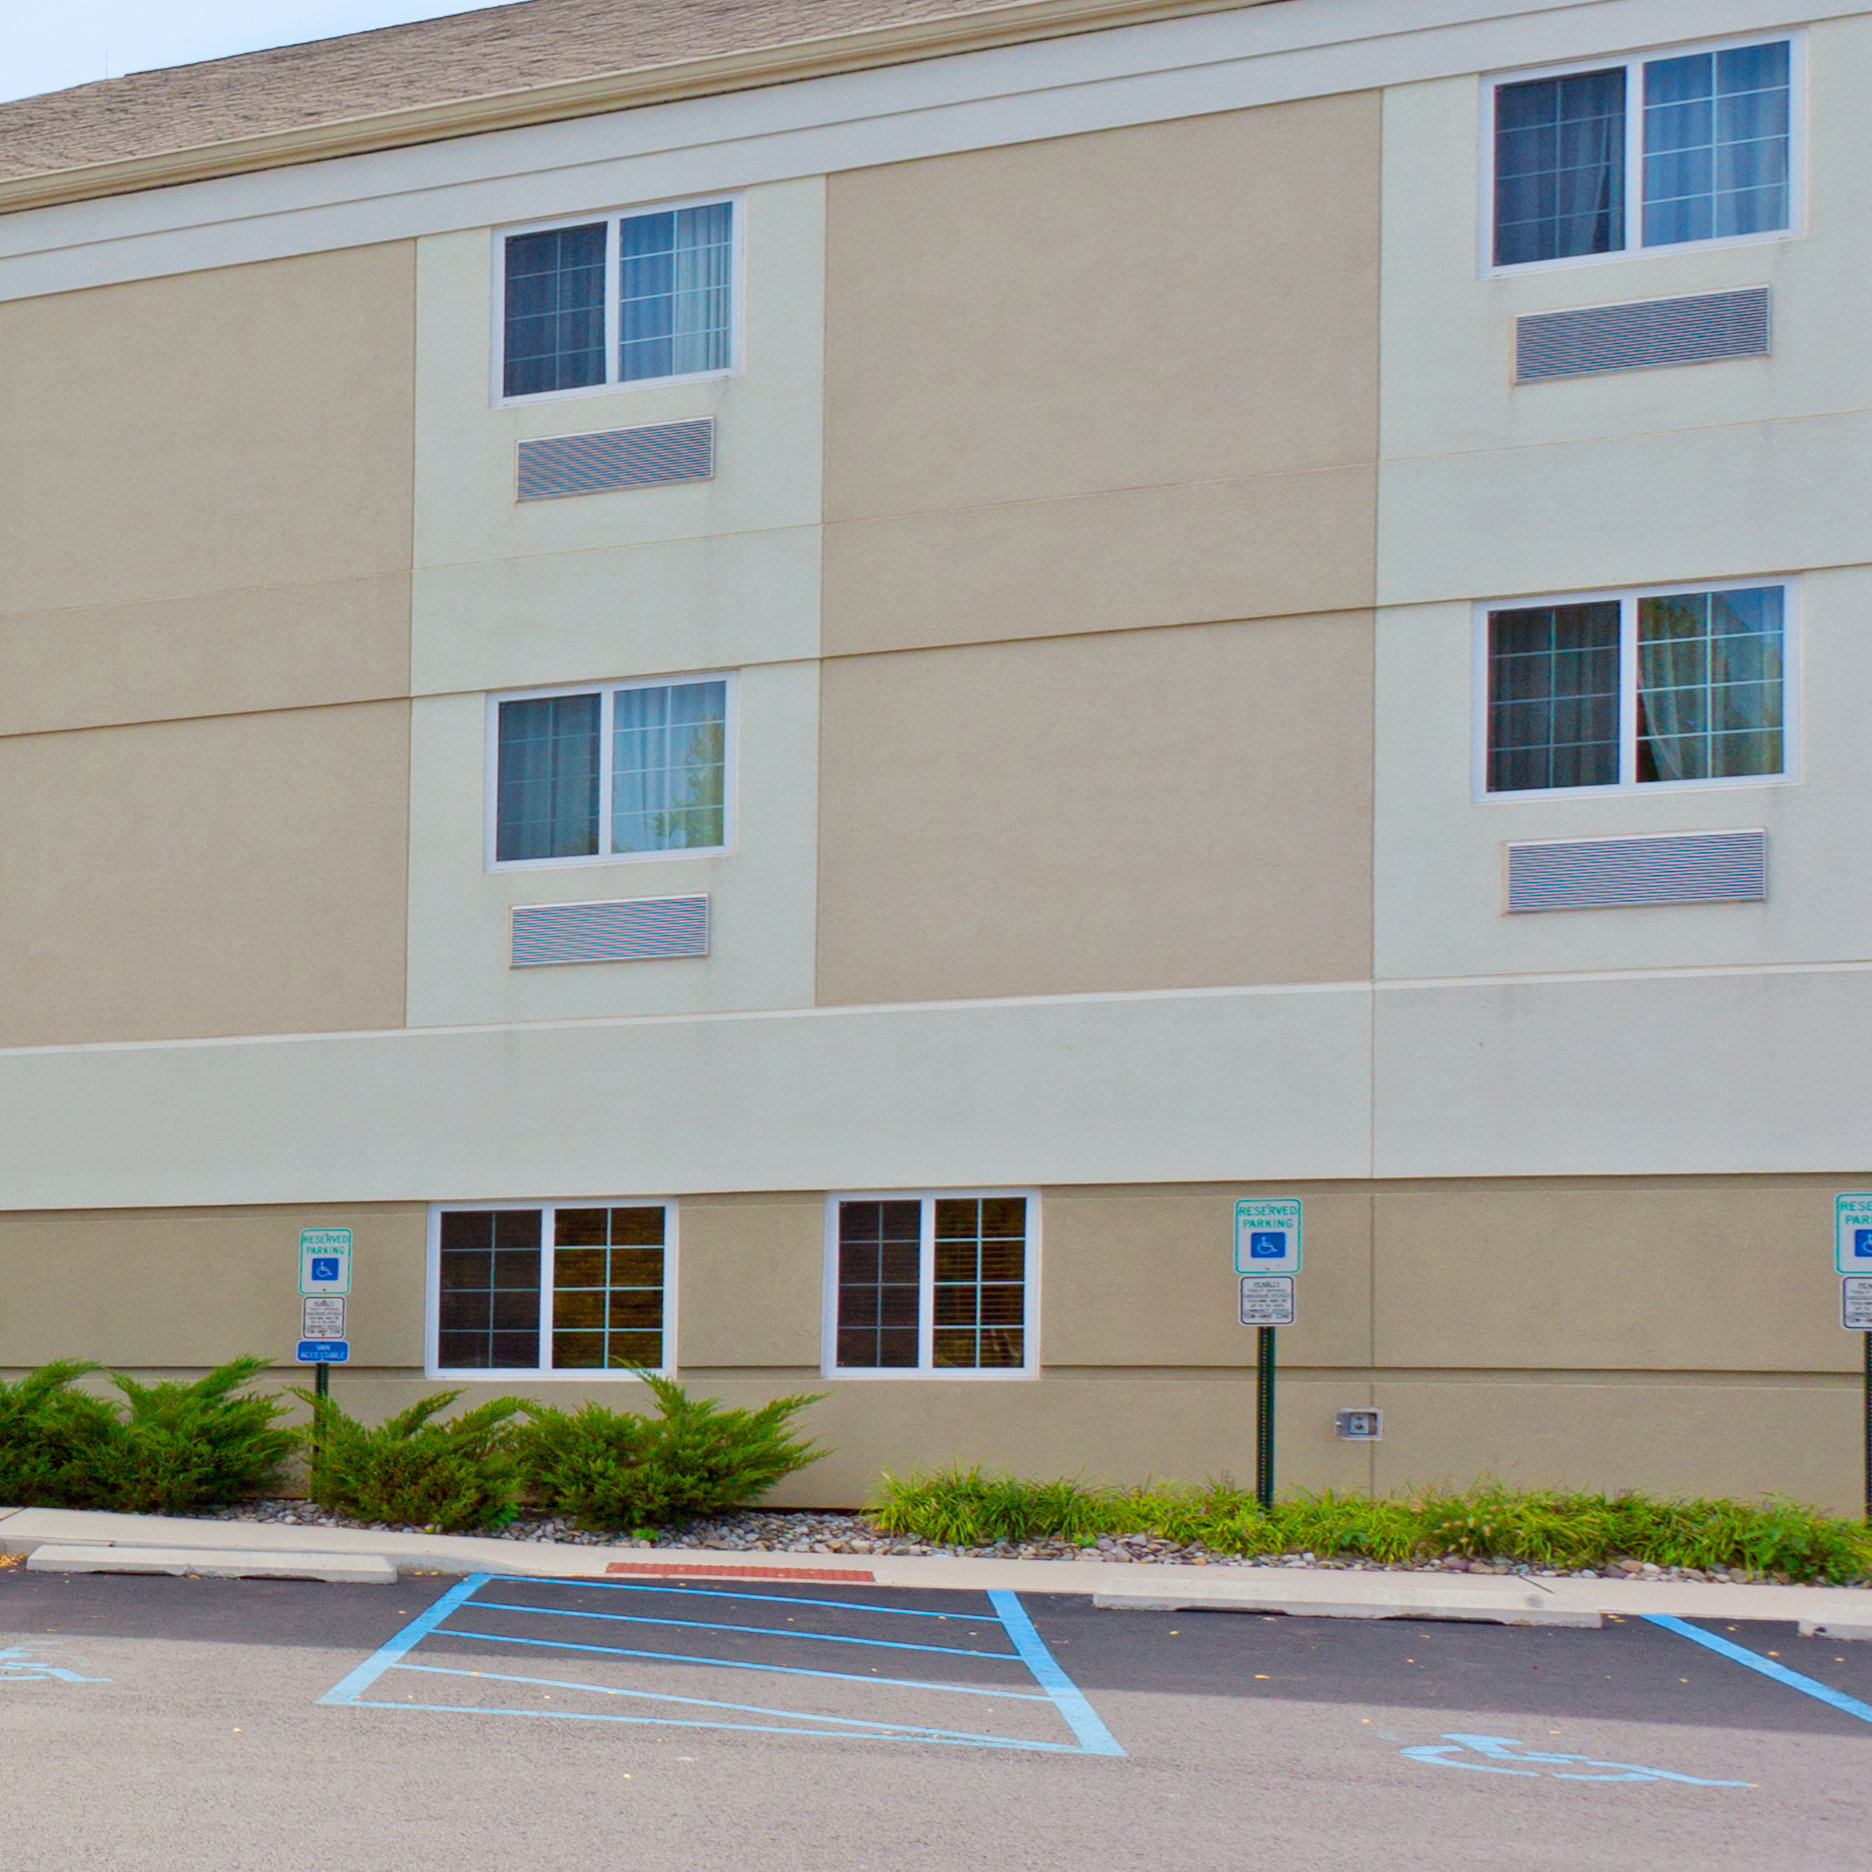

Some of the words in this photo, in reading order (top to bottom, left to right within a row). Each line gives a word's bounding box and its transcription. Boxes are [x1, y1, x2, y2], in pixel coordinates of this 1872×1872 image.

[1238, 1205, 1297, 1216] RESERVED
[1839, 1201, 1872, 1211] RESE
[1243, 1218, 1294, 1228] PARKING
[303, 1234, 349, 1244] RESERVED
[306, 1246, 346, 1255] PARKING
[299, 1351, 346, 1359] ACCESSIBLE
